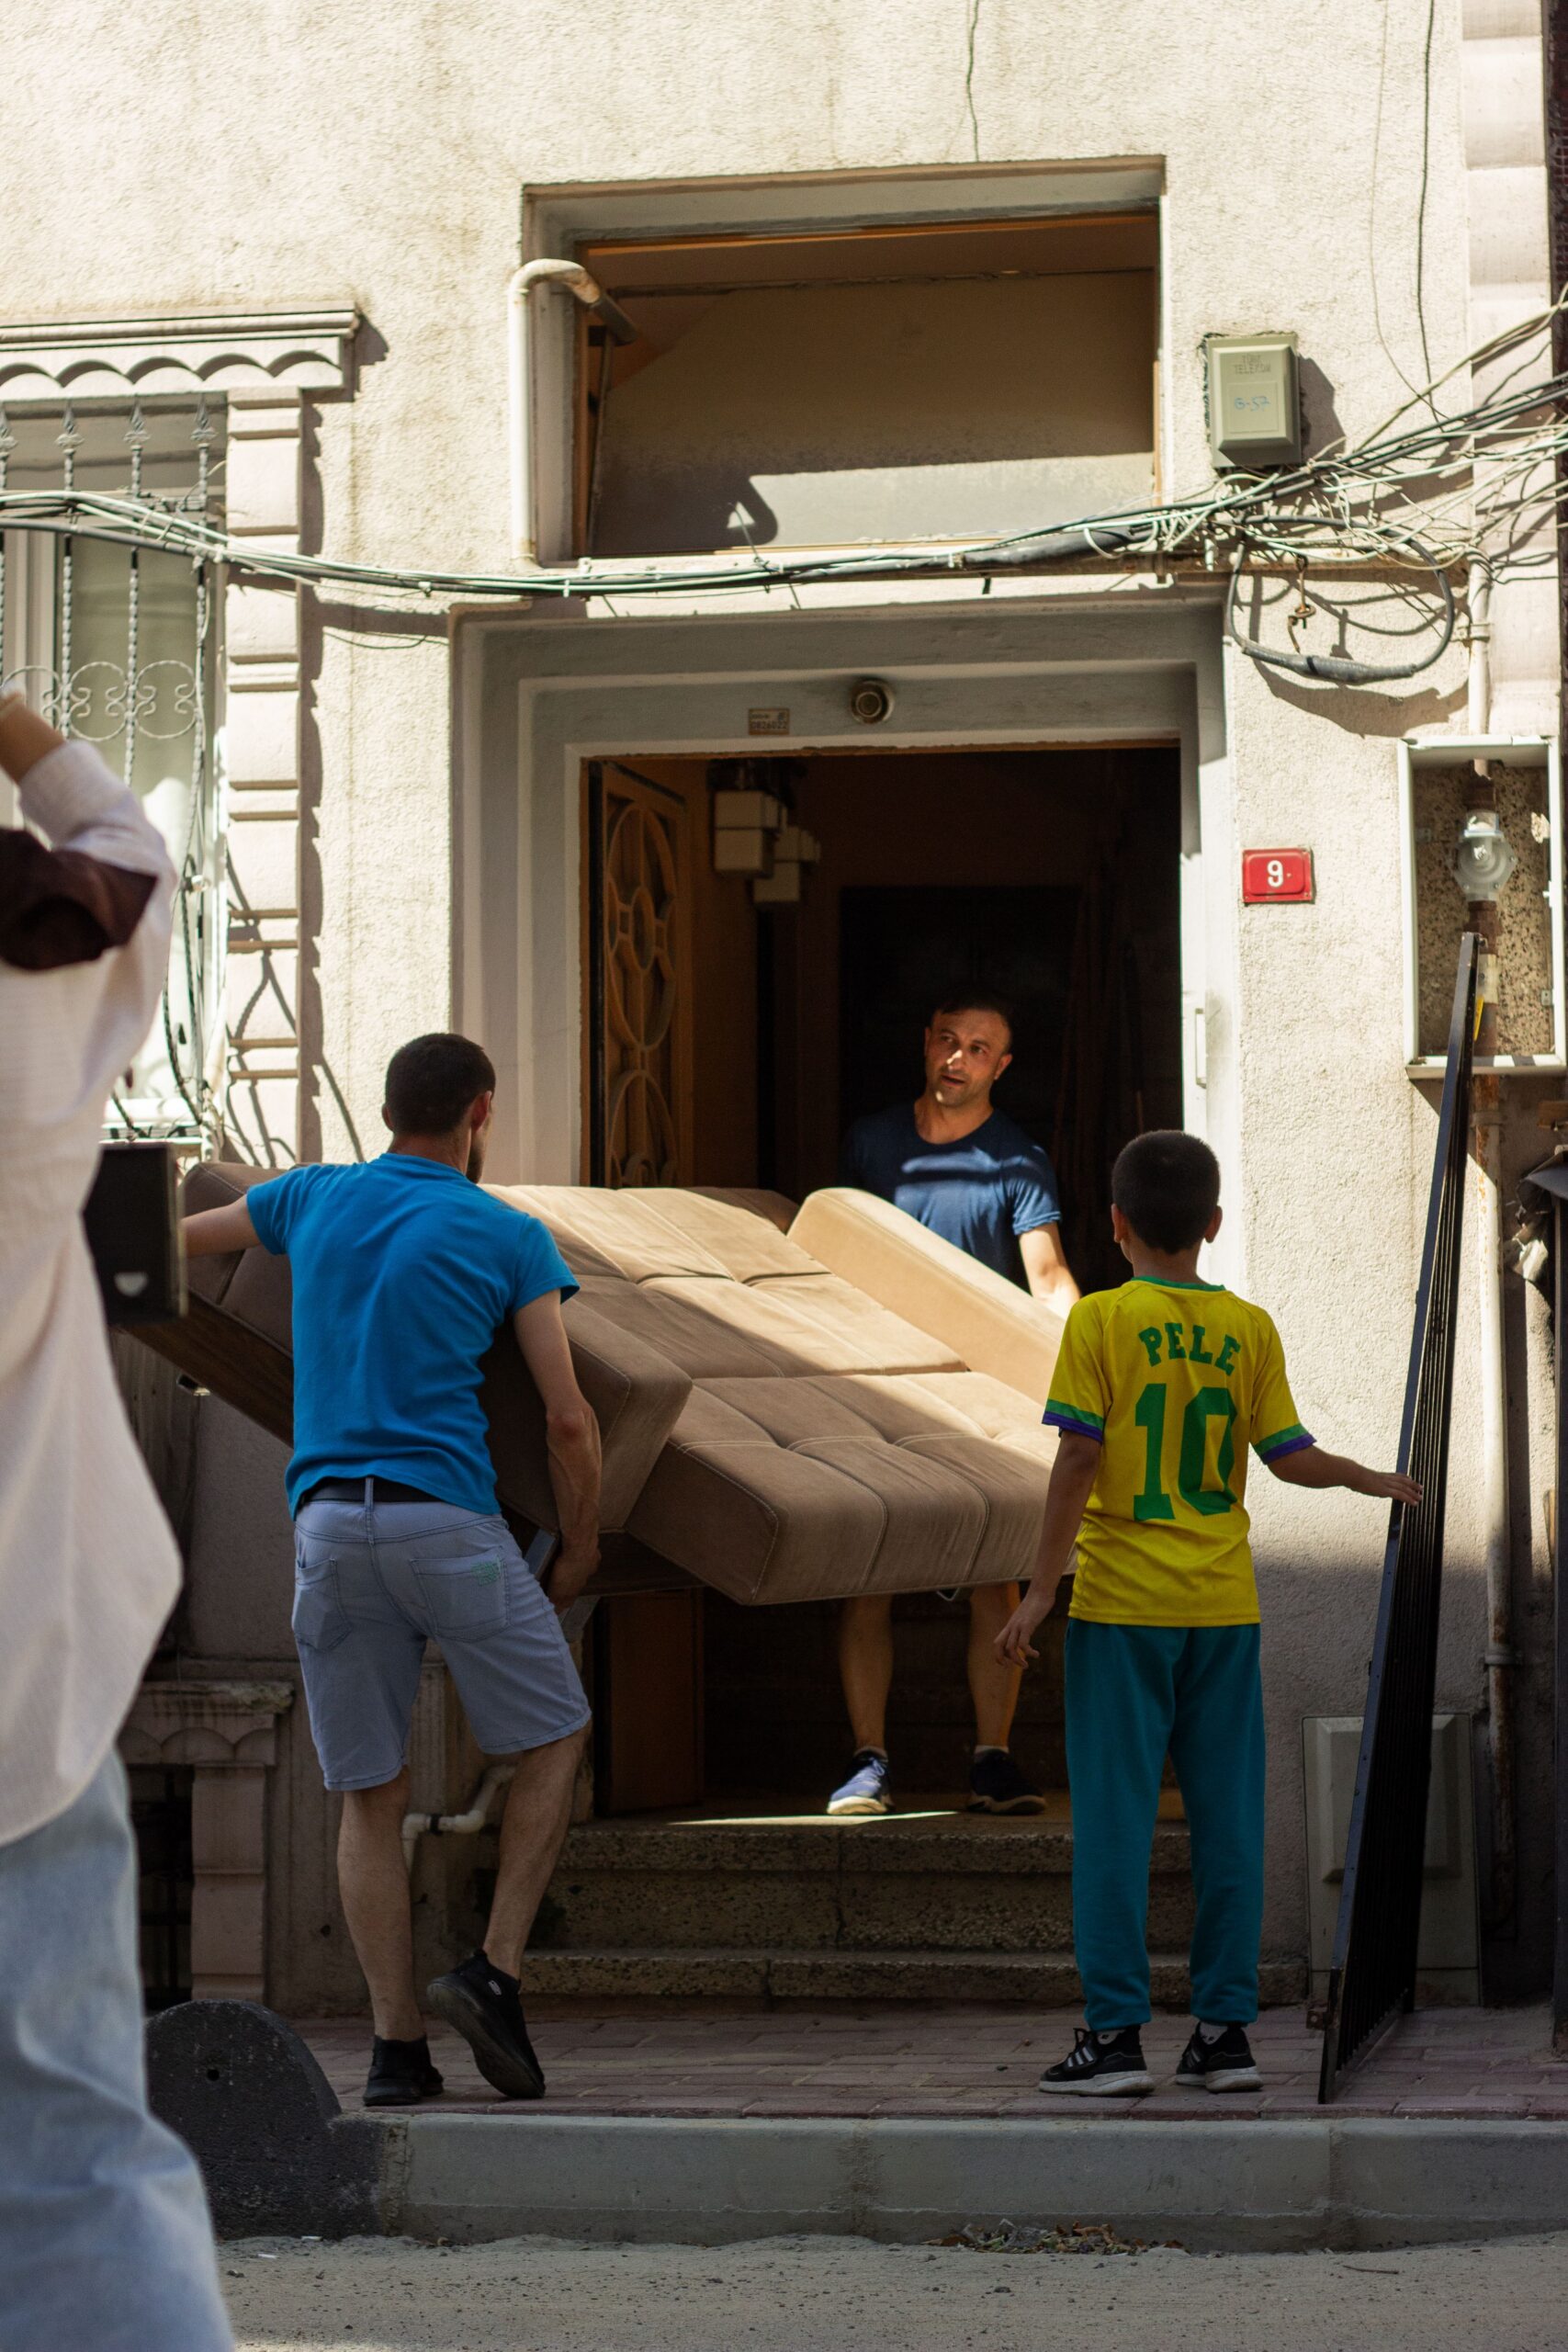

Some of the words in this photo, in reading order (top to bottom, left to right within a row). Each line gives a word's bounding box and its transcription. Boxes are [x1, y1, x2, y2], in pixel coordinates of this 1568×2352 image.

[1268, 860, 1284, 888] 9
[1138, 1322, 1241, 1376] PELE
[1134, 1383, 1237, 1521] 10
